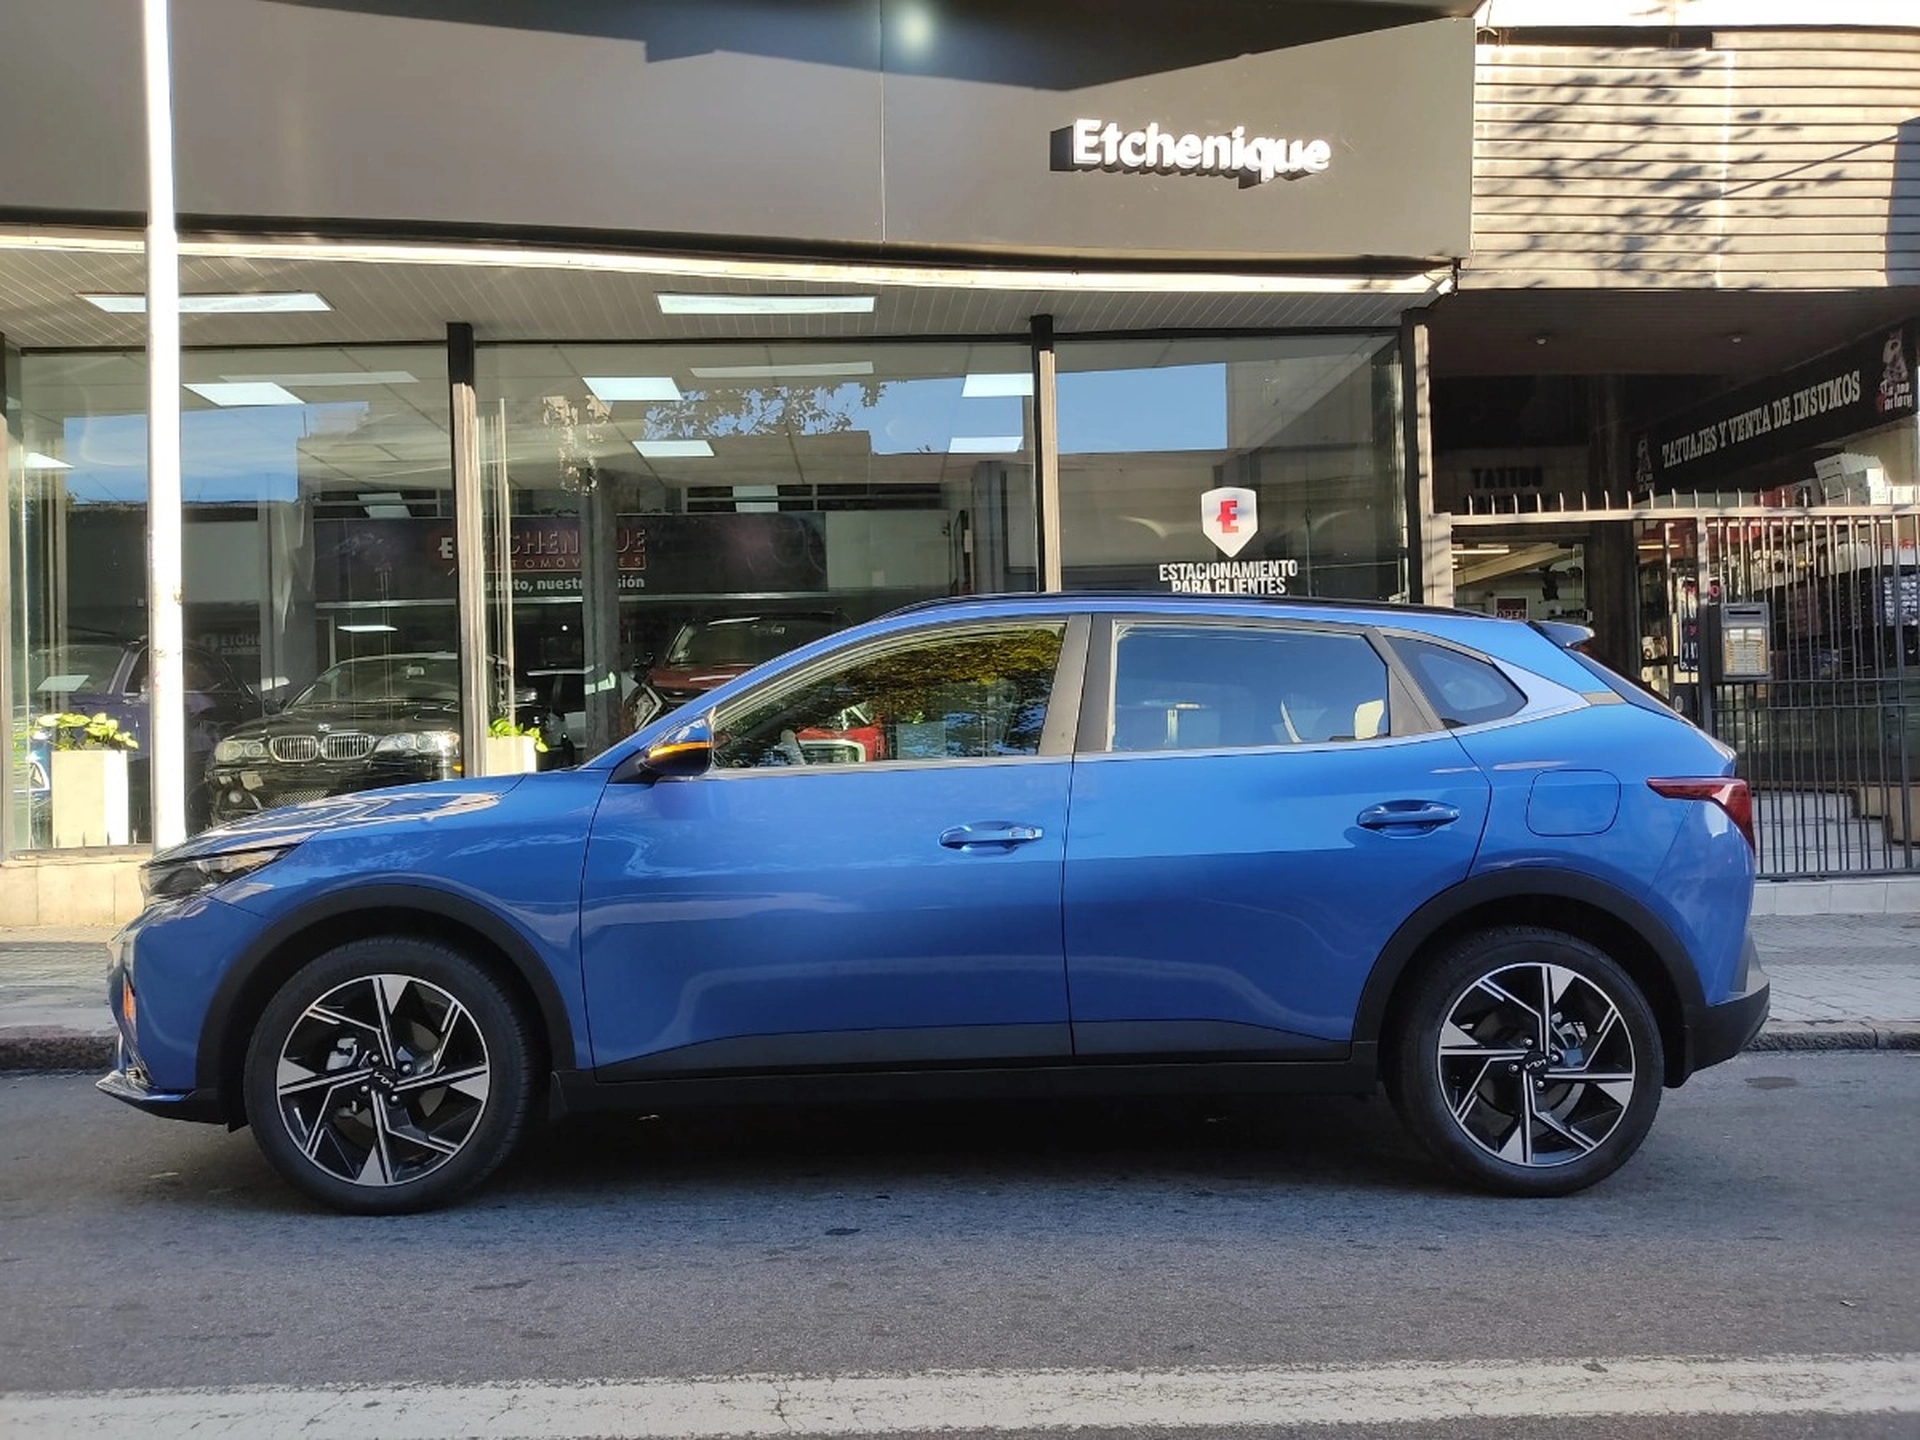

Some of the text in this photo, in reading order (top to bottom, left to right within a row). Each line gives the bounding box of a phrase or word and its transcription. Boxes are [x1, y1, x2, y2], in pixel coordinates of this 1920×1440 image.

[1073, 119, 1332, 183] Etchenique
[1661, 370, 1861, 469] TATUAJES Y VENTA DE INSUMOS
[1159, 559, 1299, 582] ESTACIONAMIENTO
[1171, 577, 1287, 594] PARA CLIENTES
